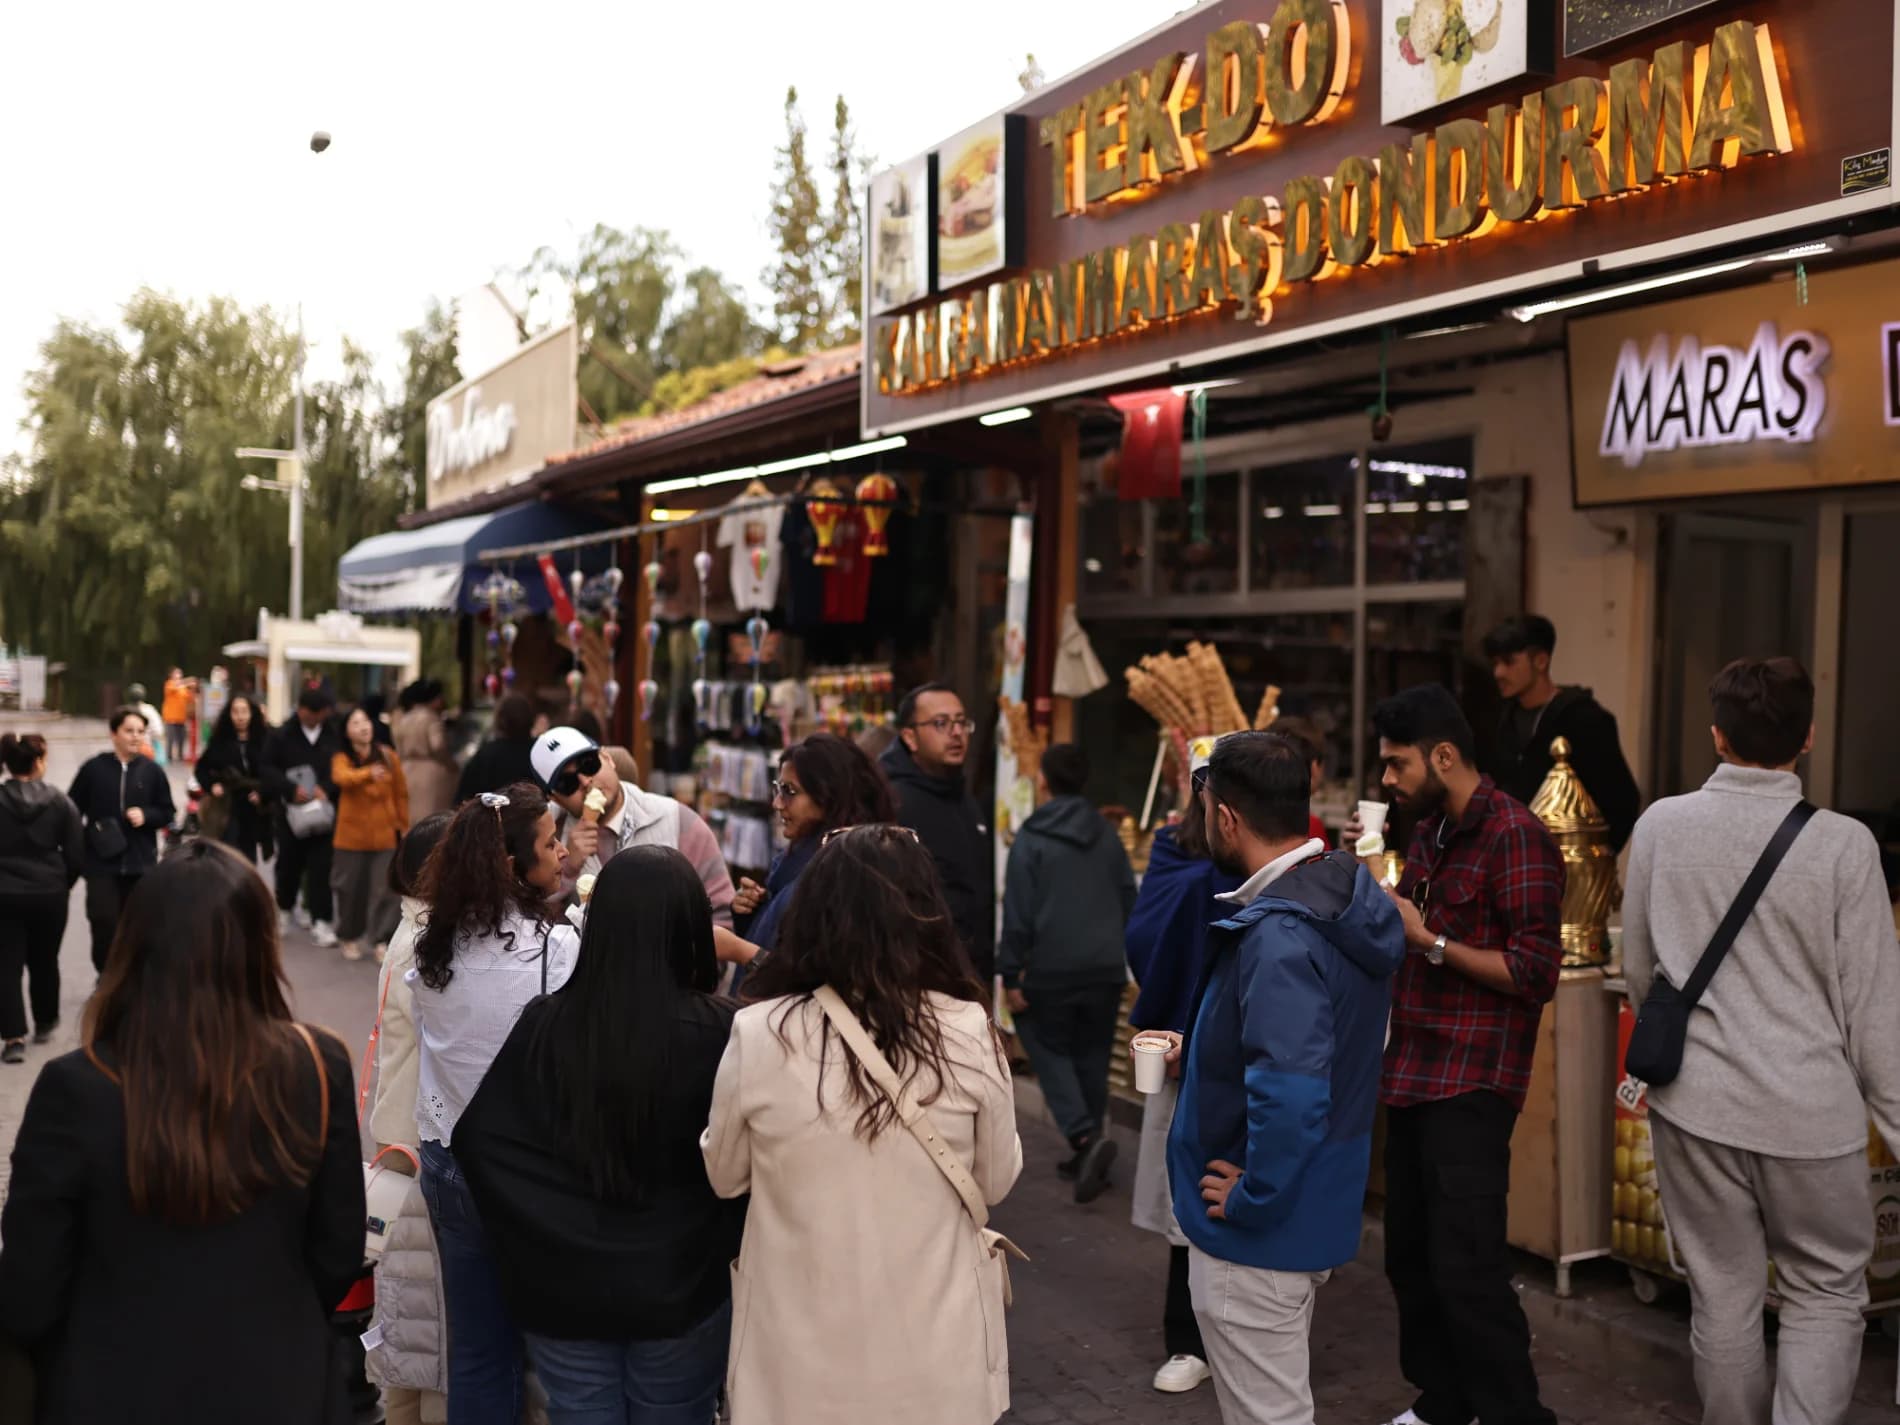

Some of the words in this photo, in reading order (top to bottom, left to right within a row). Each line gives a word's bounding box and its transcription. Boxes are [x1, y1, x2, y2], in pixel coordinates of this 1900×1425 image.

[1039, 0, 1350, 218] TEK-DO
[1284, 19, 1792, 283] DONDURMA
[1603, 331, 1818, 444] MARAŞ
